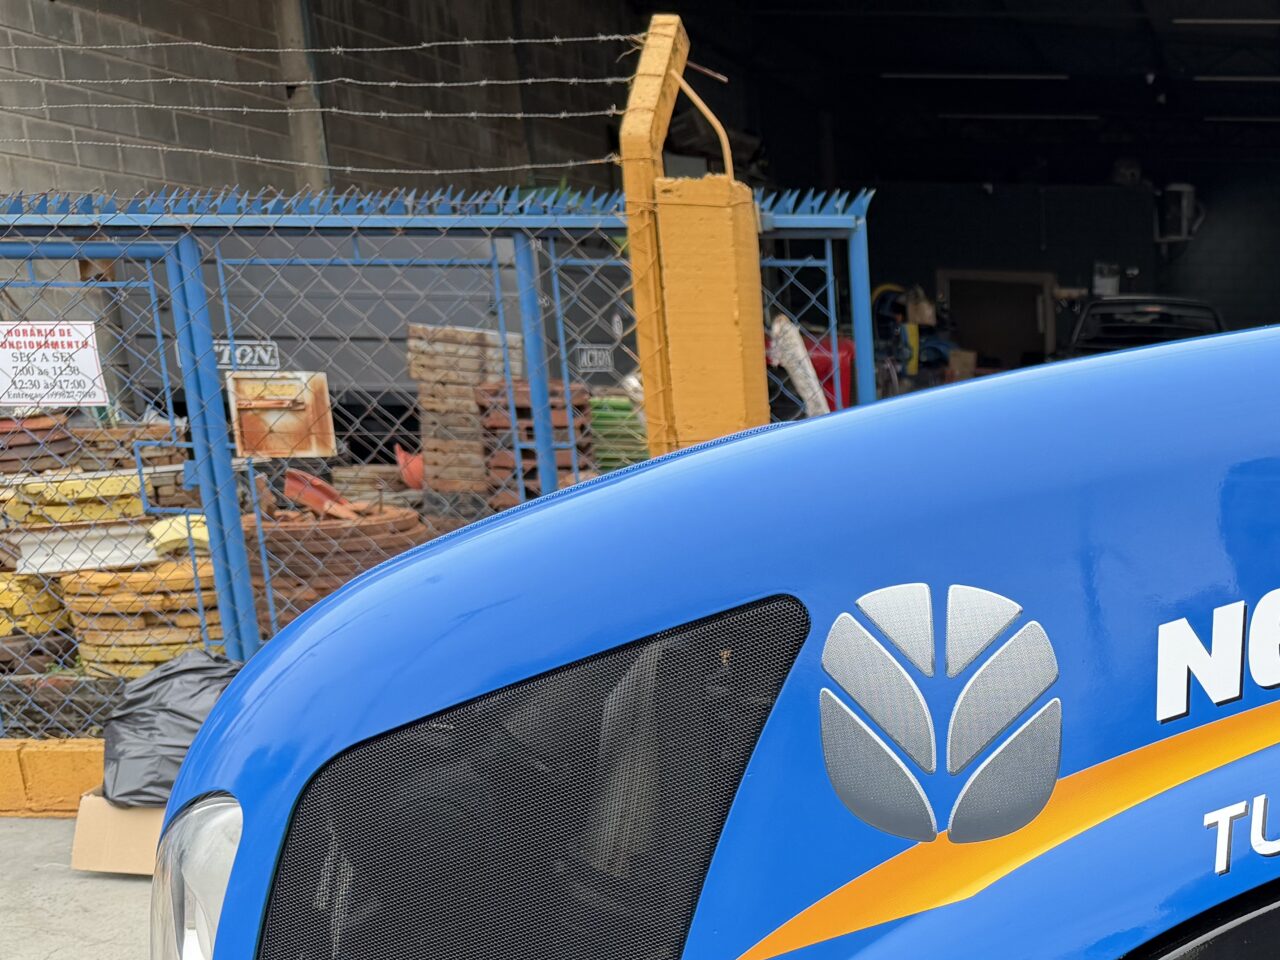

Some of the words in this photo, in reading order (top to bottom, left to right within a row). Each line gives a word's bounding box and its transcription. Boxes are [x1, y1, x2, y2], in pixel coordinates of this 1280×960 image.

[59, 328, 73, 338] DE
[0, 340, 89, 349] UNCIONAMENTO
[40, 352, 50, 362] A
[52, 351, 76, 362] SEX
[12, 379, 41, 390] 12:30
[57, 379, 86, 390] 17:00
